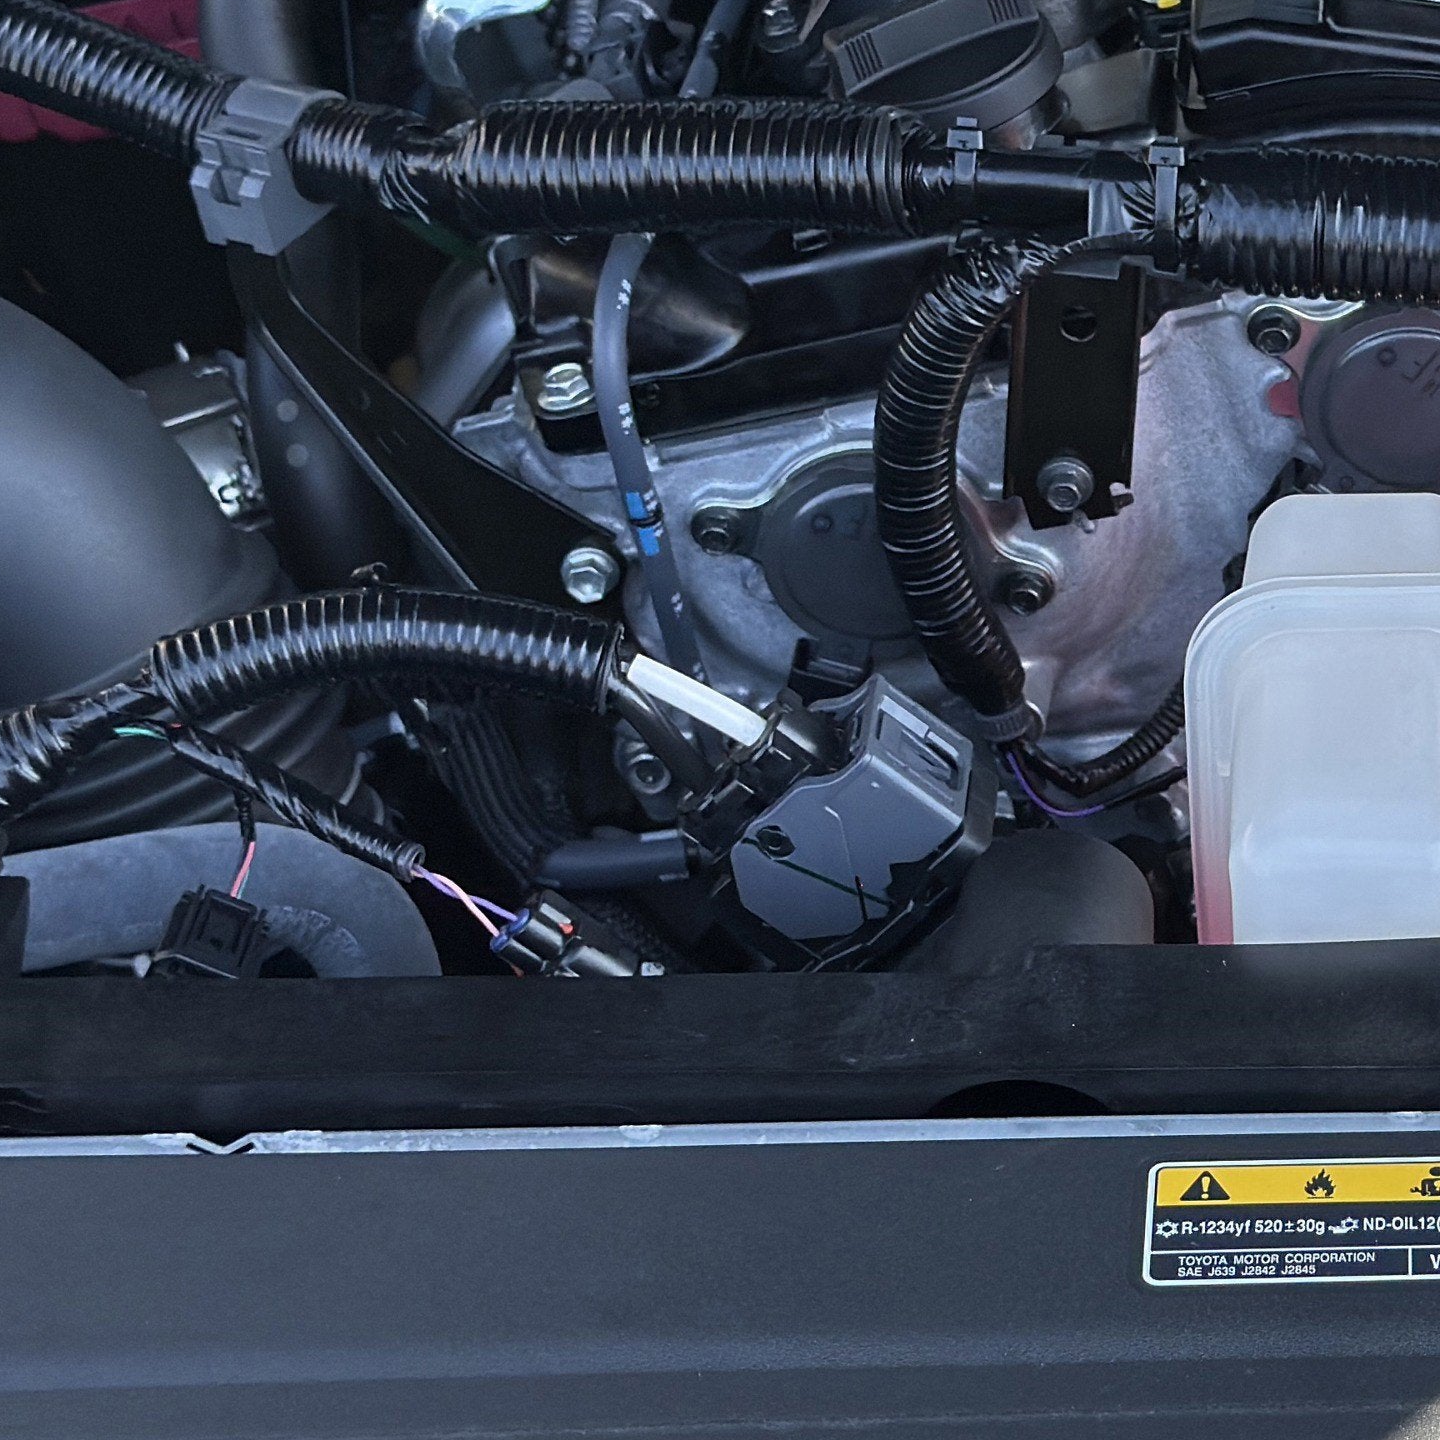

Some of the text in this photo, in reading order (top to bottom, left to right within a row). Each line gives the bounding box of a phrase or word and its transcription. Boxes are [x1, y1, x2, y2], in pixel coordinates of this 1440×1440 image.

[1181, 1219, 1250, 1237] R-1234yf
[1254, 1218, 1326, 1236] 520±30g
[1178, 1251, 1376, 1266] TOYOTA MOTOR CORPORATION
[1177, 1264, 1316, 1277] SAE J639 J2842 J2845
